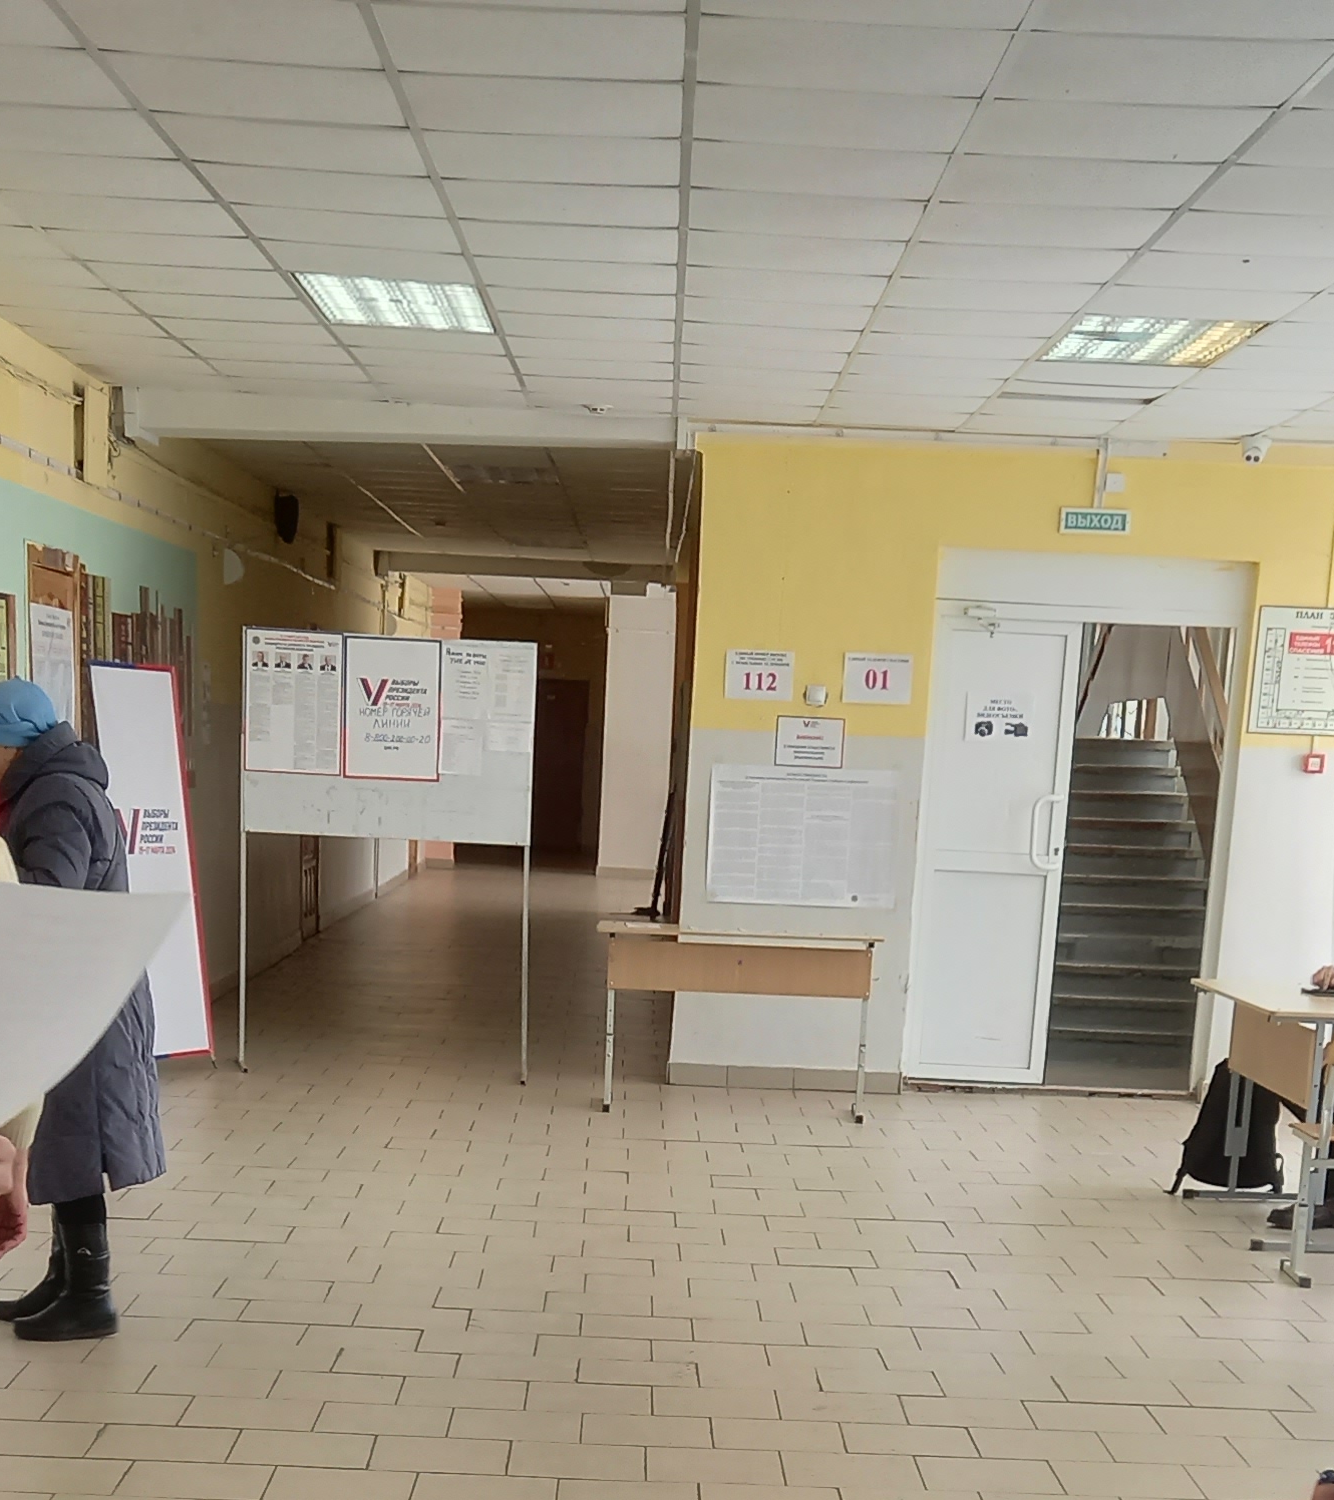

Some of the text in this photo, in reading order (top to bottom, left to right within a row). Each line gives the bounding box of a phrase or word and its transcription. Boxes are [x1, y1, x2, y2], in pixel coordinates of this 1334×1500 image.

[1067, 513, 1124, 530] ВЫХОД
[1296, 611, 1323, 620] ПЛАН
[743, 671, 777, 691] 112
[865, 669, 890, 691] 01
[359, 707, 430, 717] НОМЕР ГОРЯЧЕЙ
[373, 719, 410, 729] ЛИНИИ
